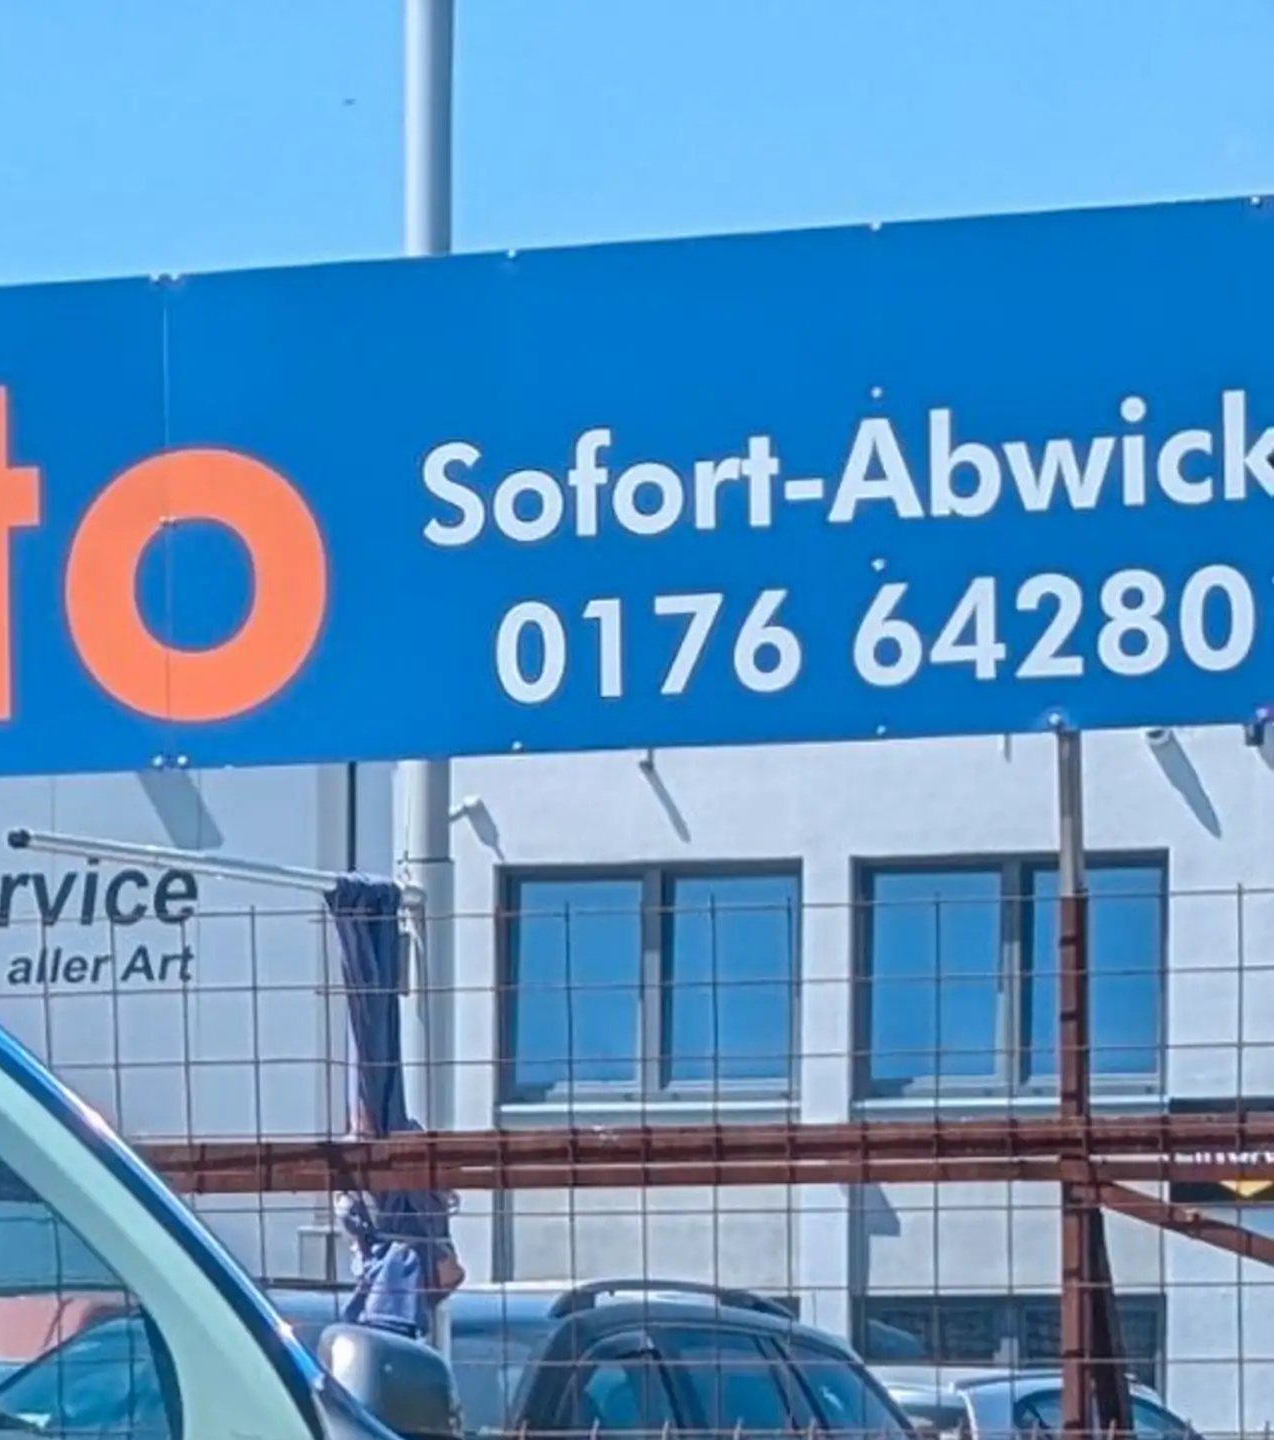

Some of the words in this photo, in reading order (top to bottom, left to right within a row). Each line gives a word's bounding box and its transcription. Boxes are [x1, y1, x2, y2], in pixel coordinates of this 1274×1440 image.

[421, 388, 1274, 547] Sofort-Abwick
[494, 587, 803, 705] 0176
[7, 946, 112, 986] aller
[120, 945, 195, 983] Art
